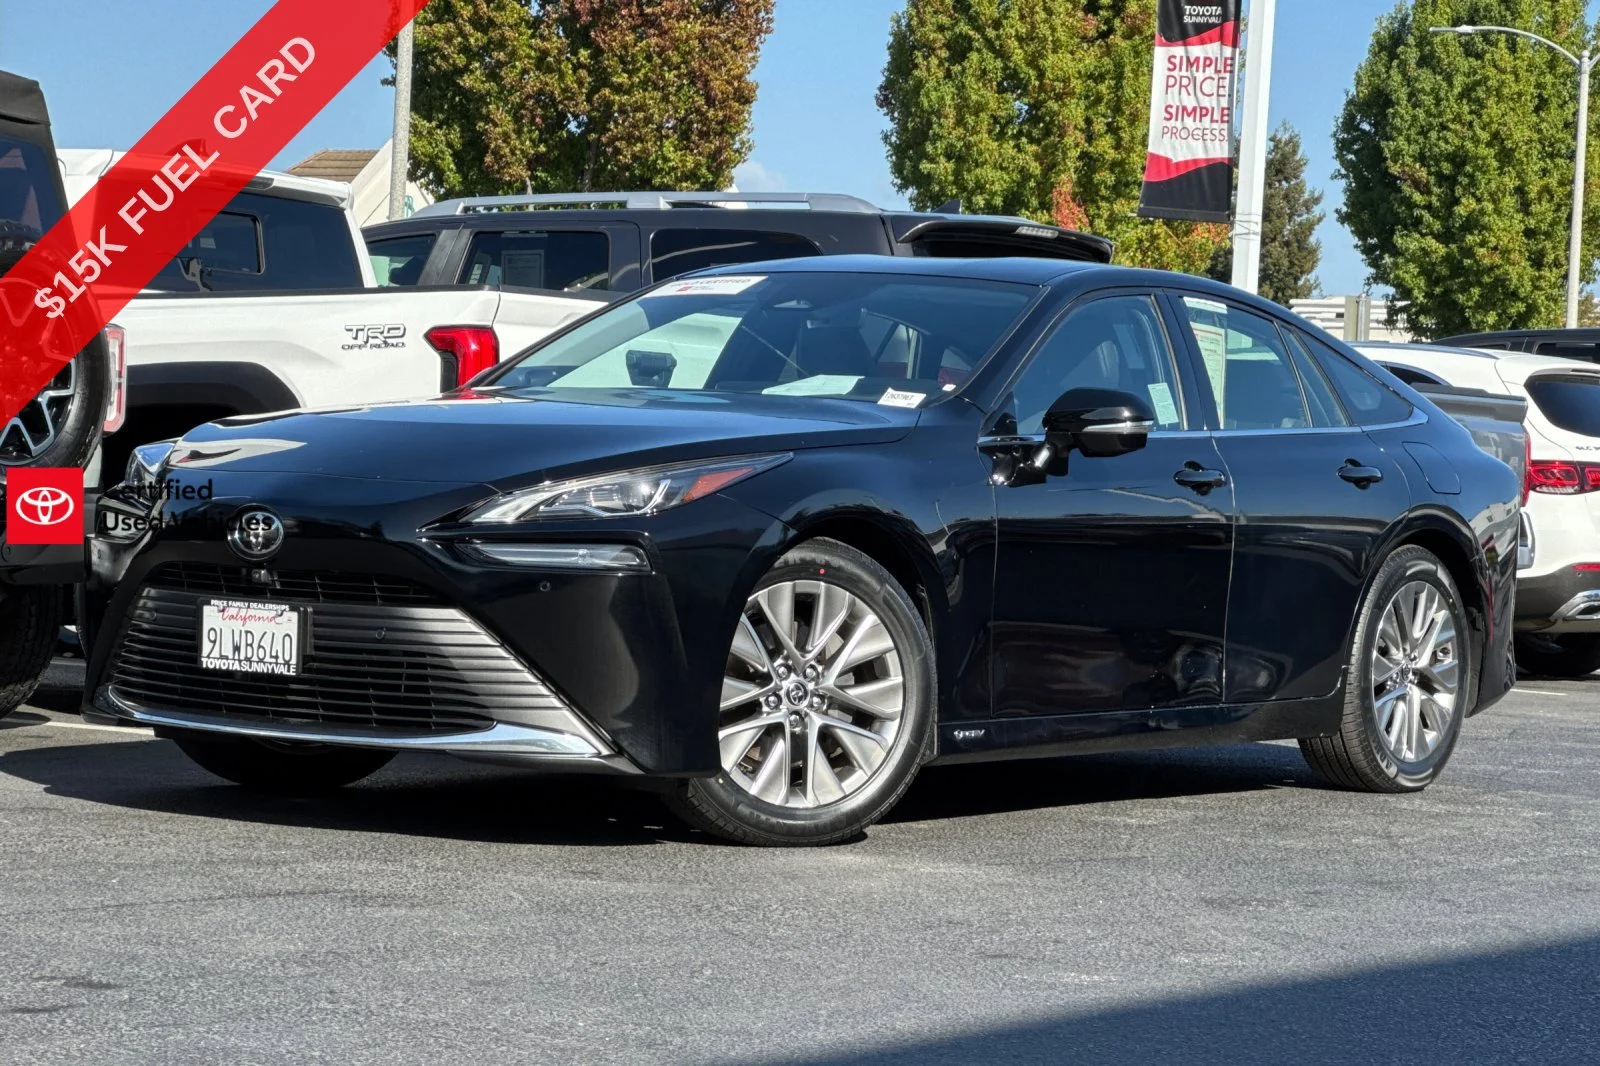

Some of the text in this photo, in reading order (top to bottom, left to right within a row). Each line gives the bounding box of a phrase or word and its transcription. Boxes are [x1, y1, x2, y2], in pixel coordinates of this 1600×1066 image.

[1184, 5, 1222, 15] TOYOTA
[1166, 54, 1234, 74] SIMPLE
[1163, 104, 1230, 124] SIMPLE
[344, 323, 406, 344] TRD
[210, 599, 228, 608] PRICE
[228, 600, 249, 609] FAMILY
[220, 606, 282, 627] California
[206, 627, 293, 664] 9LWB640
